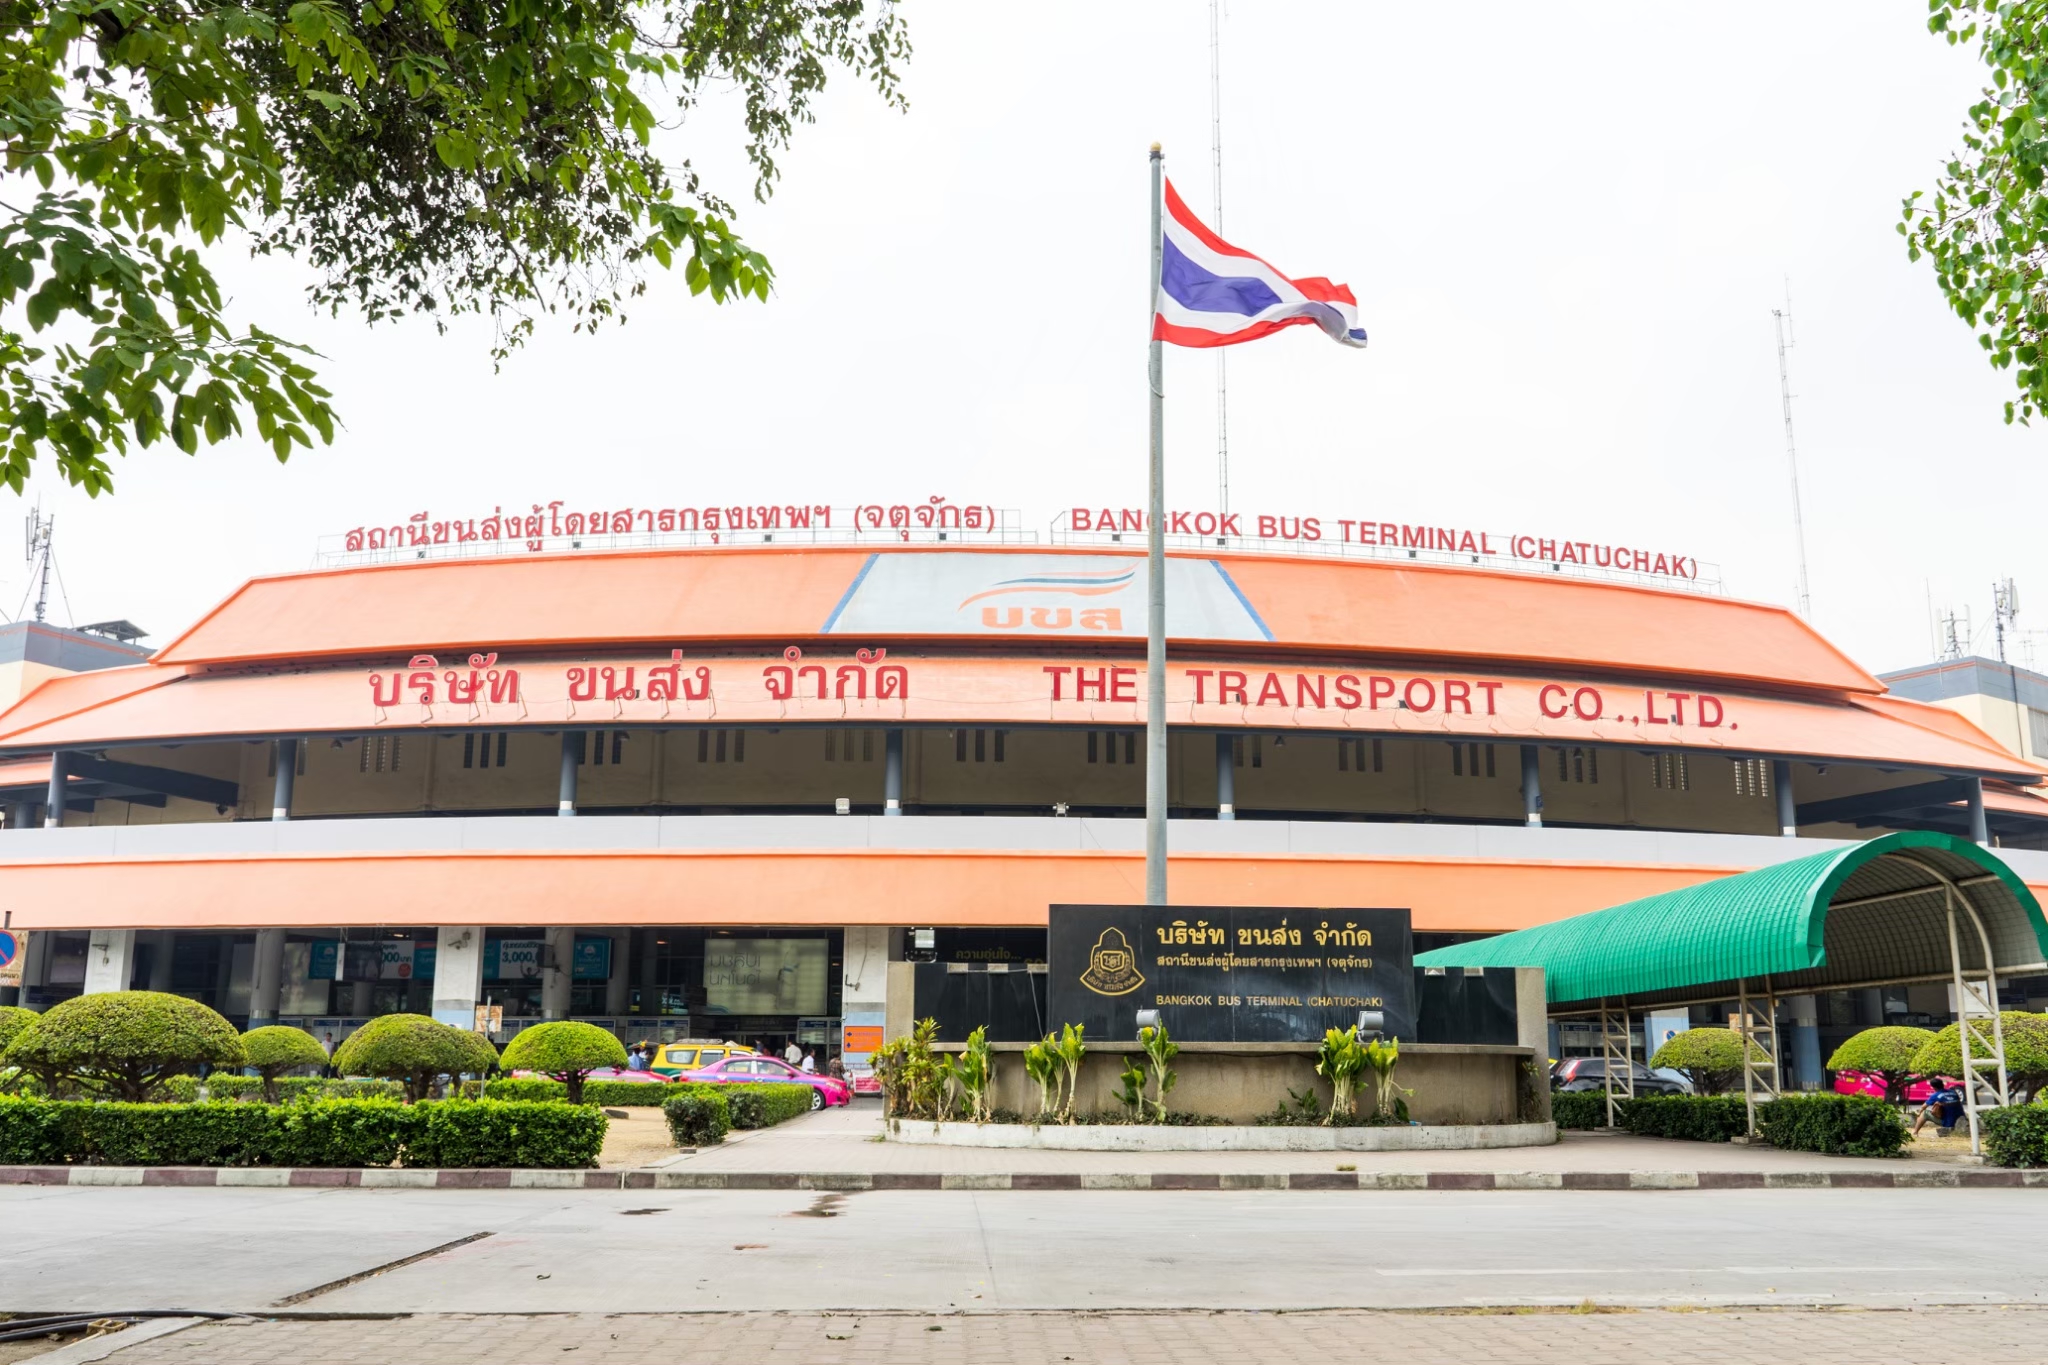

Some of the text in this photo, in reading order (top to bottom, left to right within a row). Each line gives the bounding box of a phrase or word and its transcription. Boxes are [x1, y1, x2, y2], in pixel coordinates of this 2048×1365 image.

[345, 495, 996, 553] สถานีขนส่งผู้โดยสารกรุงเทพฯ (จตุจักร)
[1258, 515, 1322, 541] BUS
[1339, 519, 1496, 556] TERMINAL
[1511, 534, 1698, 580] (CHATUCHAK)
[981, 606, 1123, 631] บขส
[369, 645, 909, 708] บริษัท ขนส่ง จำกัด
[1043, 666, 1138, 703] THE
[1186, 669, 1503, 716] TRANSPORT
[1157, 918, 1373, 947] บริษัท ขนส่ง จำกัด
[1327, 955, 1373, 972] (จตุจักร)
[1156, 995, 1383, 1008] BANGKOK BUS TERMINAL (CHATUCHAK)
